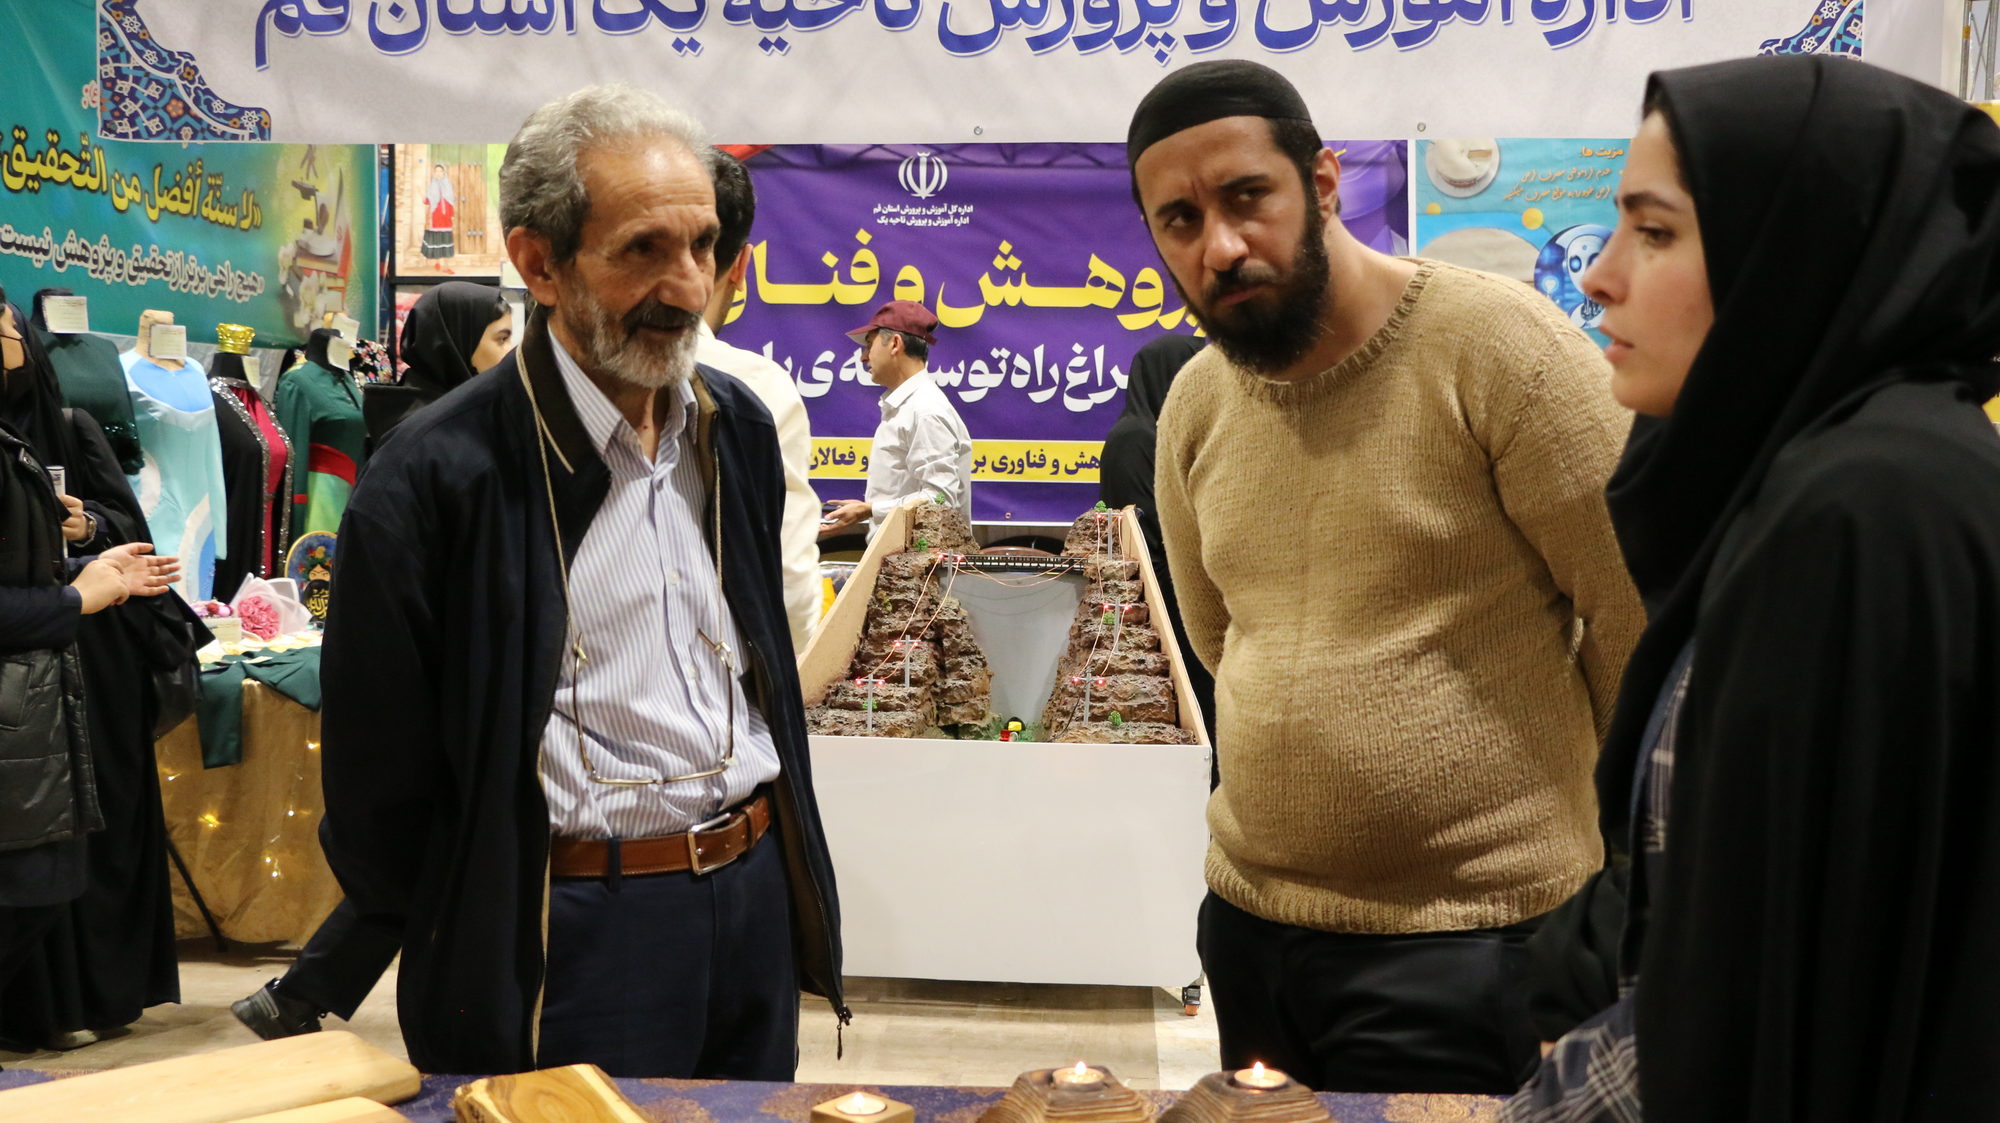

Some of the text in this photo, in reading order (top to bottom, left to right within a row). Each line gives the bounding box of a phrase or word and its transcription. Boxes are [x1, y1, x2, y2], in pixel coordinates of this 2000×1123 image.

[110, 169, 143, 213] من
[873, 203, 974, 215] اداره کل آموزش و پرورش استان قم
[876, 215, 970, 227] اداره آموزش و پرورش ناحیه یک
[0, 224, 52, 268] نیست
[53, 229, 116, 285] پژوهش
[127, 244, 175, 286] تحقیق
[114, 250, 126, 282] و
[169, 251, 184, 291] از
[207, 260, 236, 299] راهی
[1010, 344, 1060, 403] راه
[1063, 342, 1129, 412] راغ
[859, 455, 869, 472] و
[991, 449, 1047, 475] فناوری
[1049, 457, 1060, 475] و
